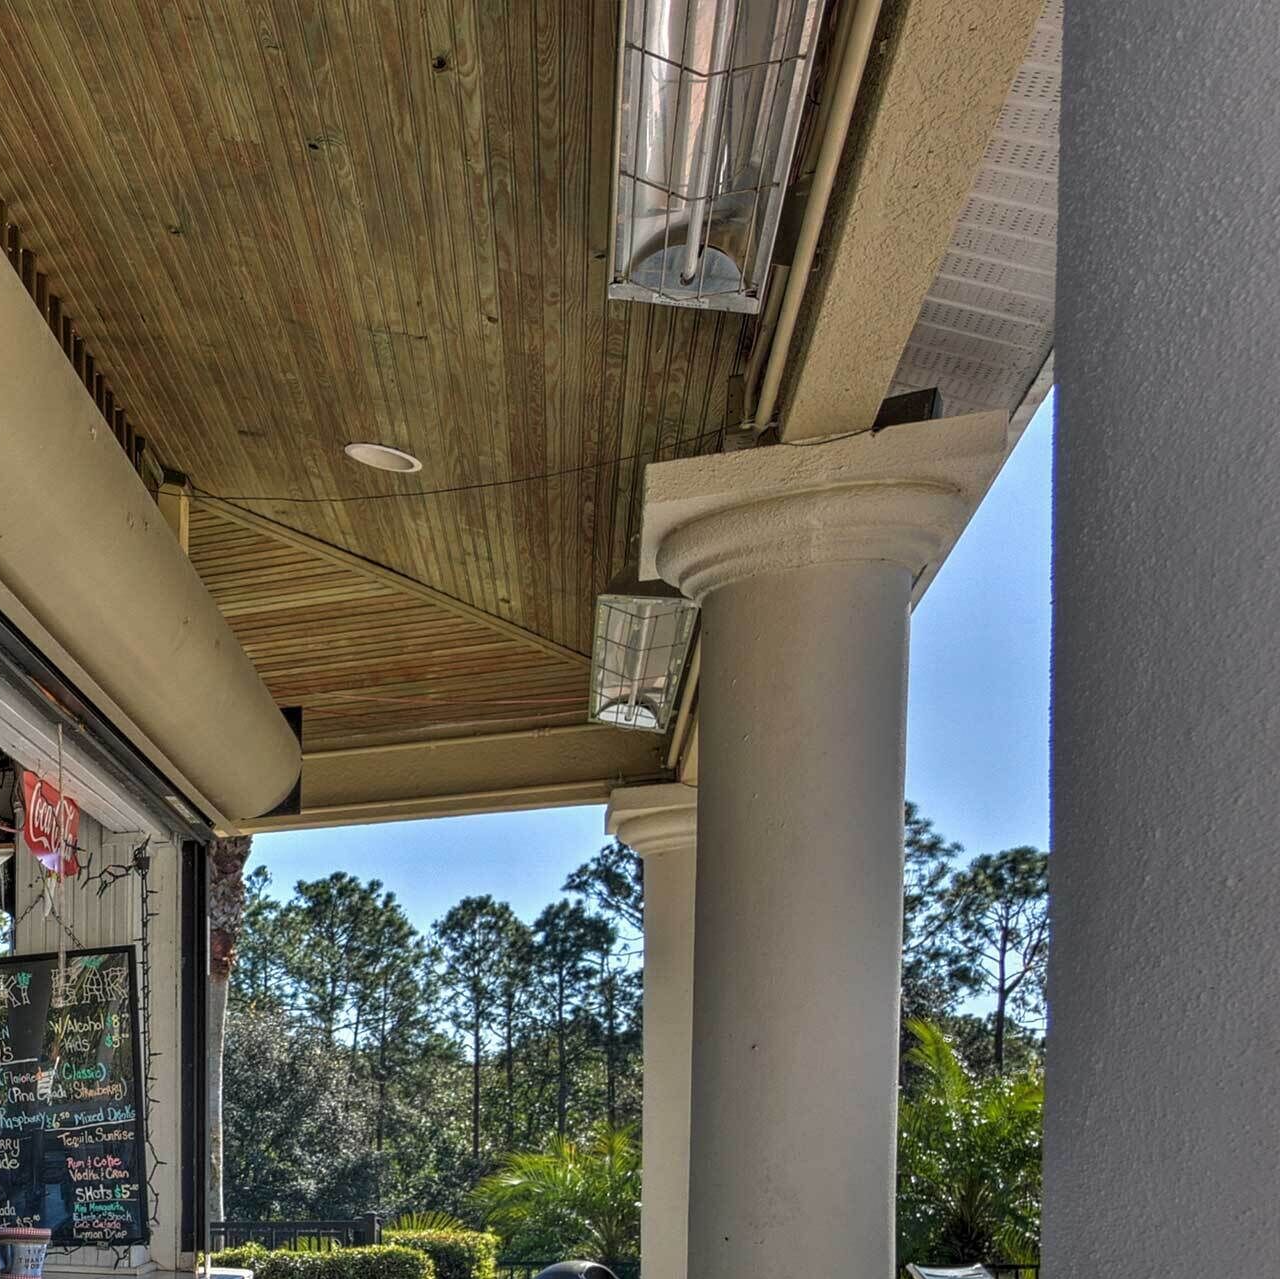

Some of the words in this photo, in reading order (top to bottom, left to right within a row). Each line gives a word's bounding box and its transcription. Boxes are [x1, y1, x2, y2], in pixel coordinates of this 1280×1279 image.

[74, 1106, 104, 1126] Mixed
[94, 1155, 122, 1167] Coke
[69, 1168, 100, 1182] Vodka
